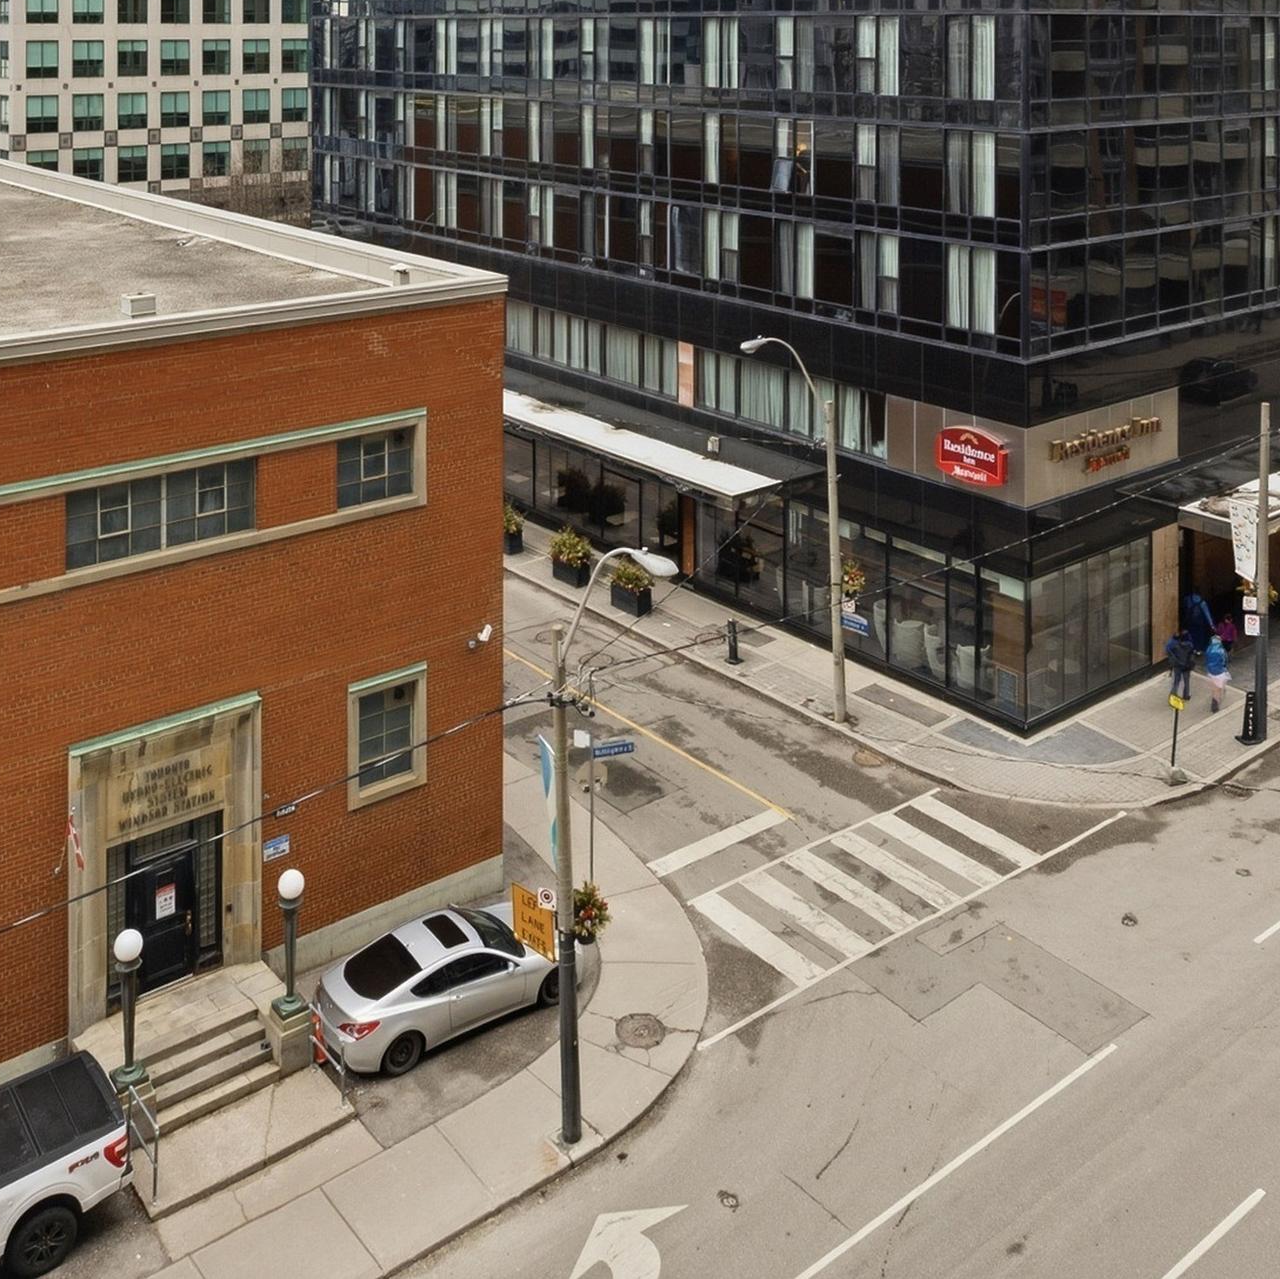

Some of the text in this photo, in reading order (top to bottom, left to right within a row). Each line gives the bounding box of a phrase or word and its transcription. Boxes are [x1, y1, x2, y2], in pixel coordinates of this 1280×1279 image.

[943, 439, 996, 463] Residence
[1049, 424, 1131, 463] Residence
[145, 759, 190, 782] TORONTO
[118, 789, 216, 831] WINDSOR STATION
[521, 911, 545, 935] LANE
